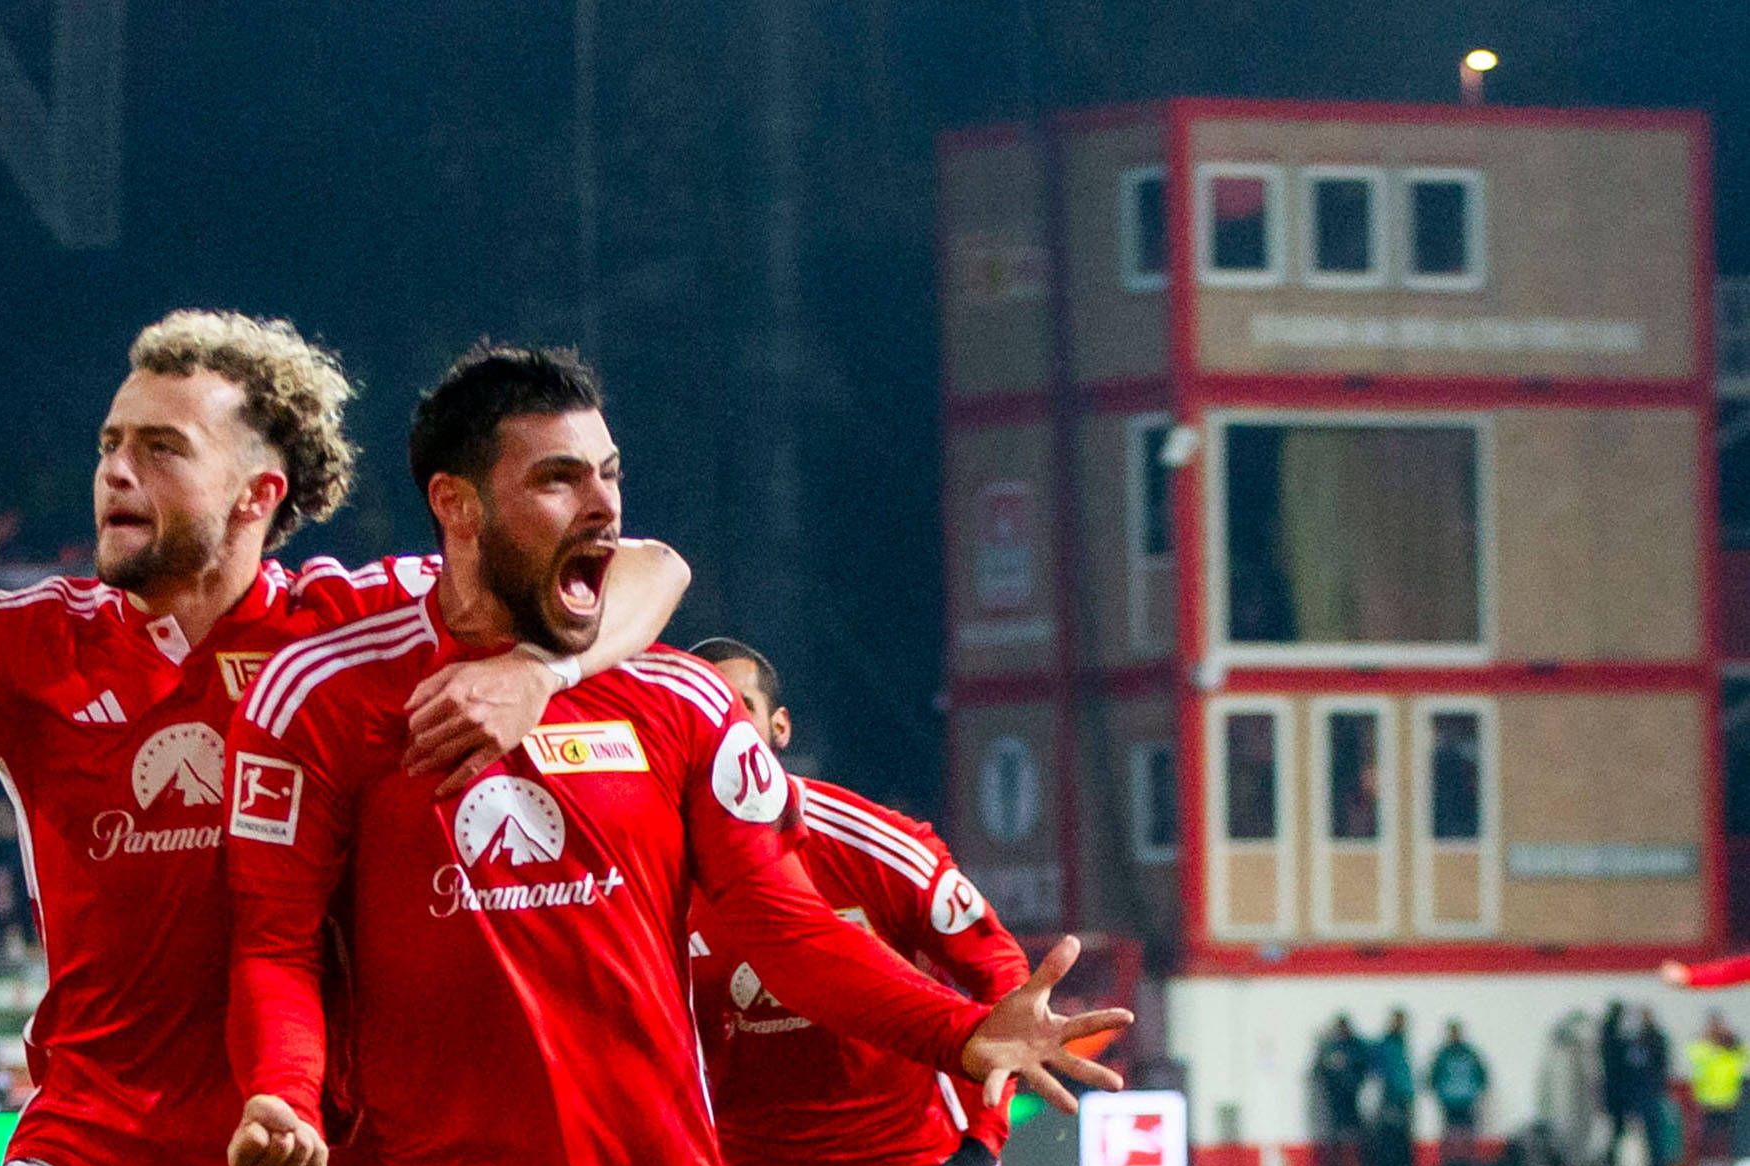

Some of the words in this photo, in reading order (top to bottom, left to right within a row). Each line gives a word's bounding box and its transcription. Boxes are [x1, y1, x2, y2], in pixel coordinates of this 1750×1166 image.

[590, 741, 635, 759] UNION
[734, 742, 773, 806] JD
[428, 863, 625, 918] Paramount+
